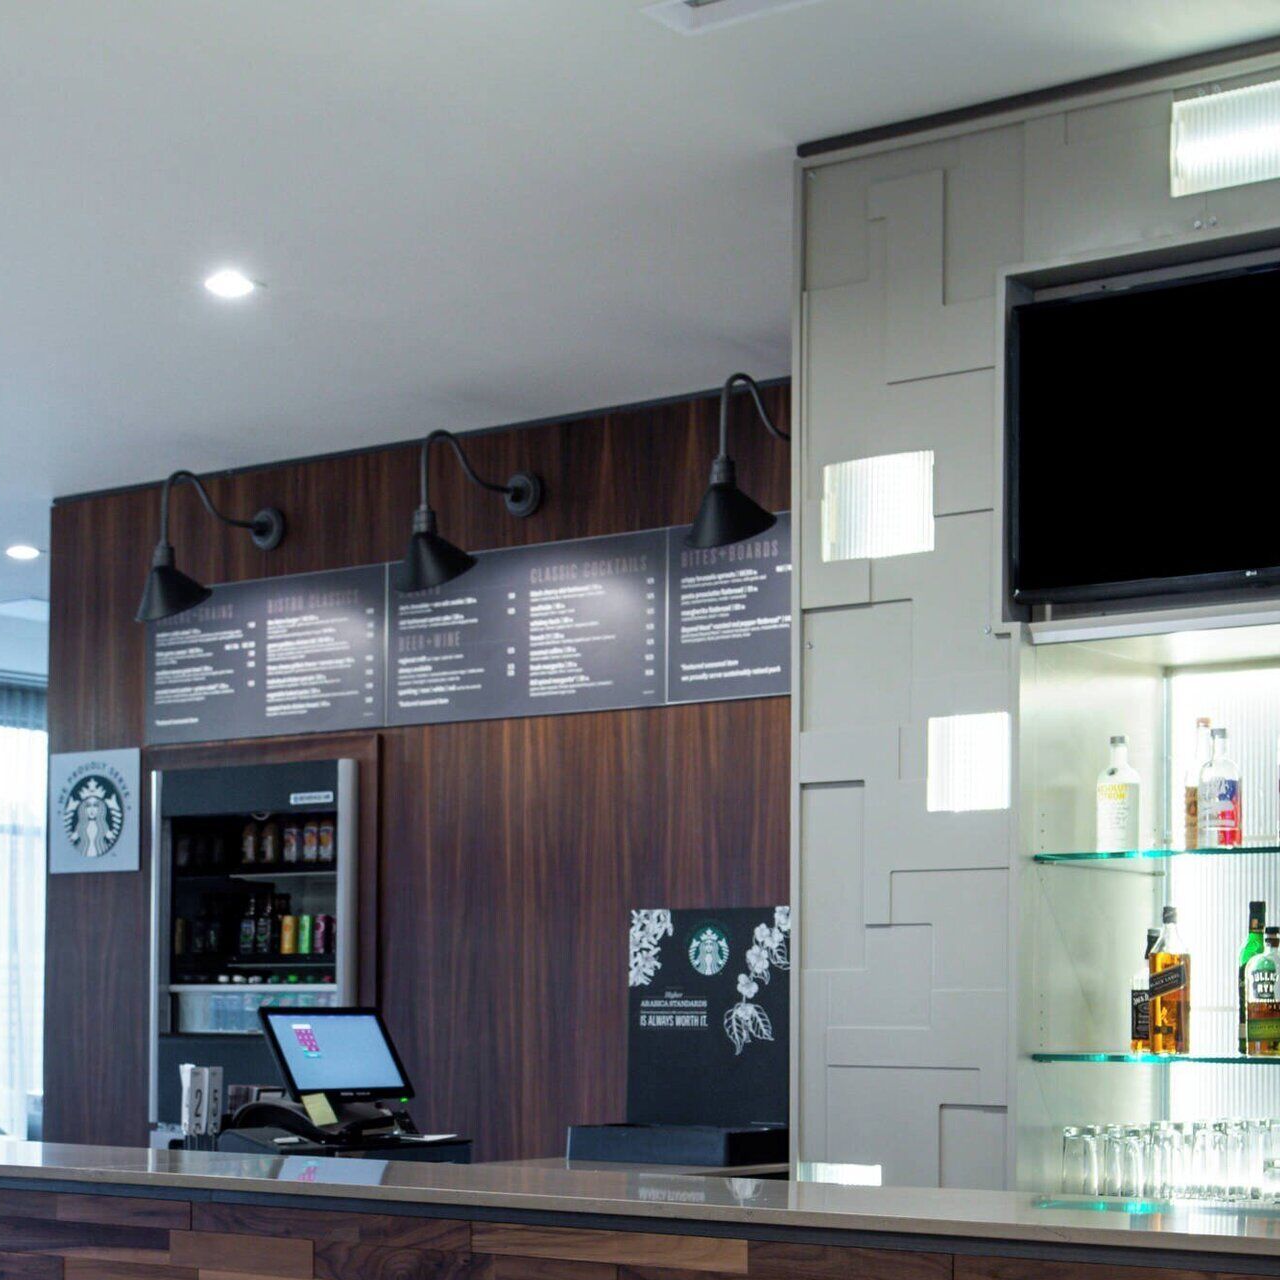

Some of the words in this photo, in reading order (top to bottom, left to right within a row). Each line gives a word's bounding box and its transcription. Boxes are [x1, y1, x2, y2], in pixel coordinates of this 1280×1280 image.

[530, 563, 578, 584] CLASSIC
[584, 554, 648, 578] COCKTAILS
[68, 761, 107, 784] PROUDLY
[648, 1015, 674, 1027] ALWAYS
[675, 1015, 699, 1027] WORTH
